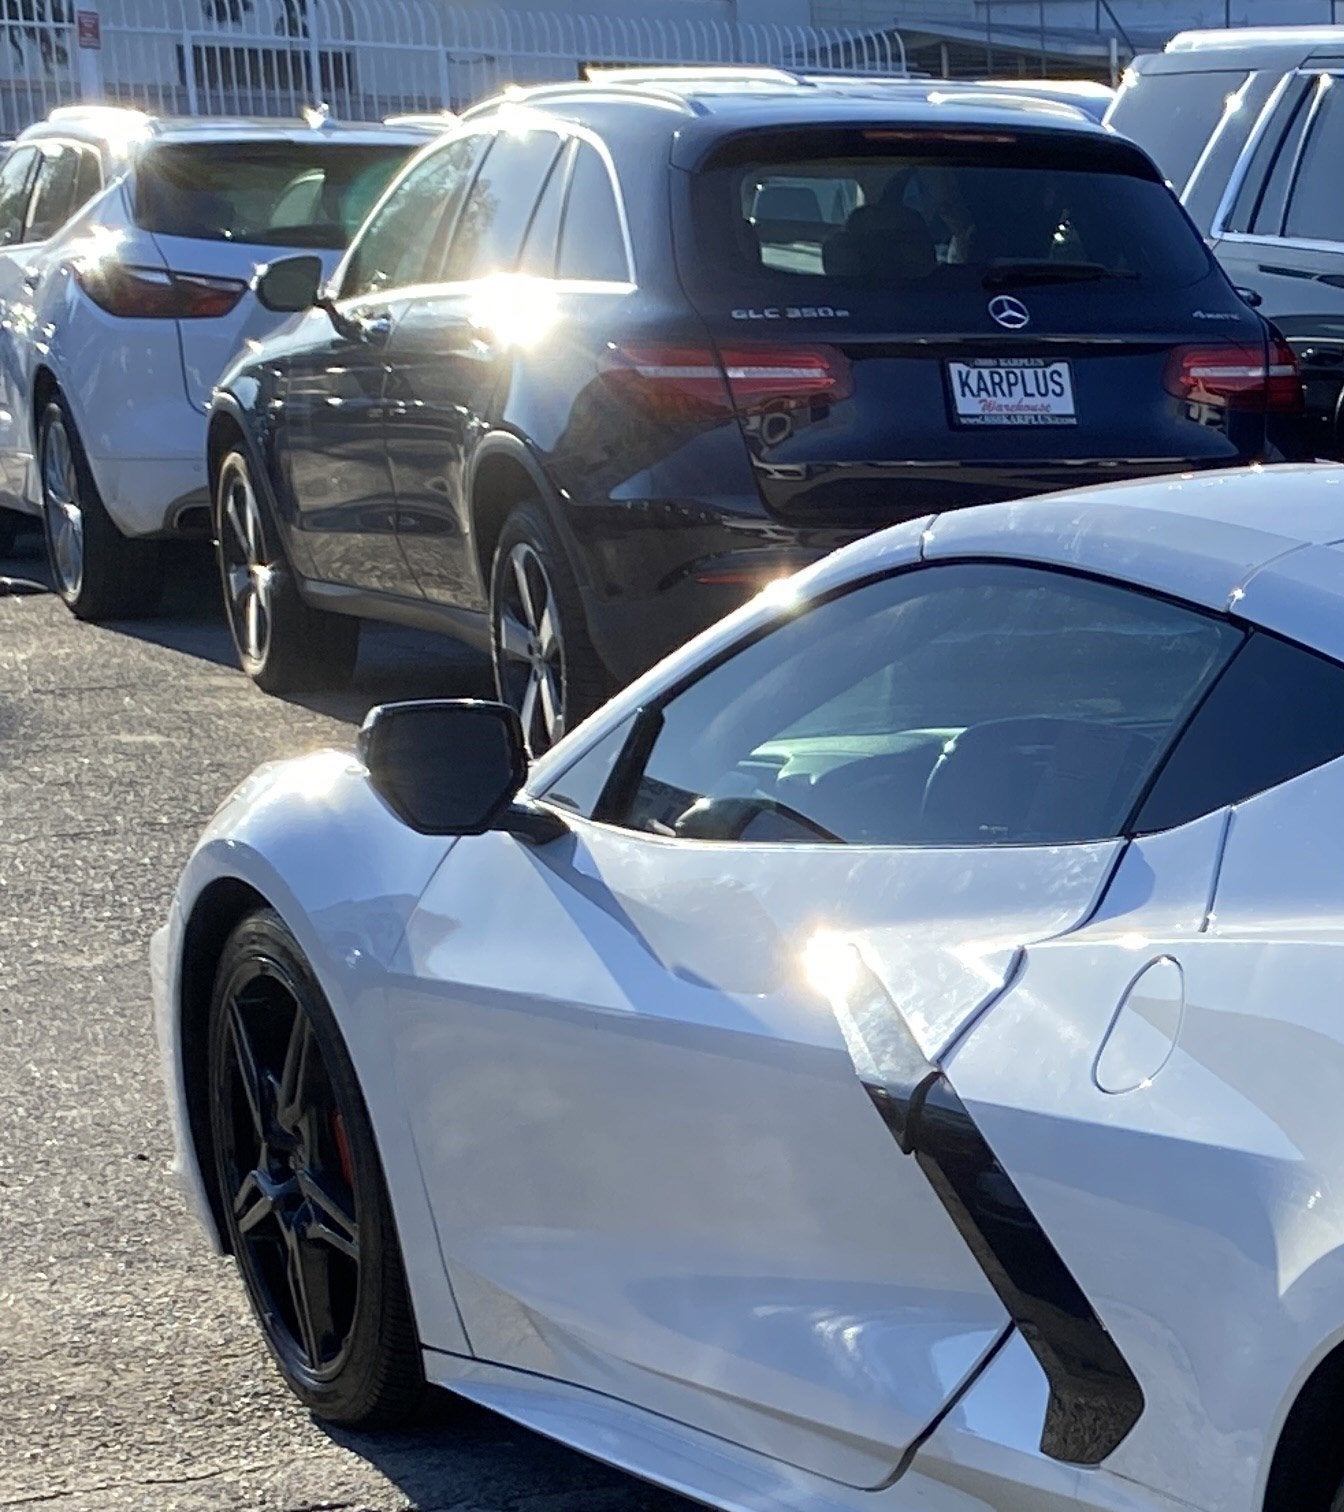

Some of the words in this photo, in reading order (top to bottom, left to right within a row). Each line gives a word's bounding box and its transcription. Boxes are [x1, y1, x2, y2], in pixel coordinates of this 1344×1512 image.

[731, 307, 780, 319] GLC
[957, 369, 1065, 398] KARPLUS
[977, 397, 1052, 413] Warehouse
